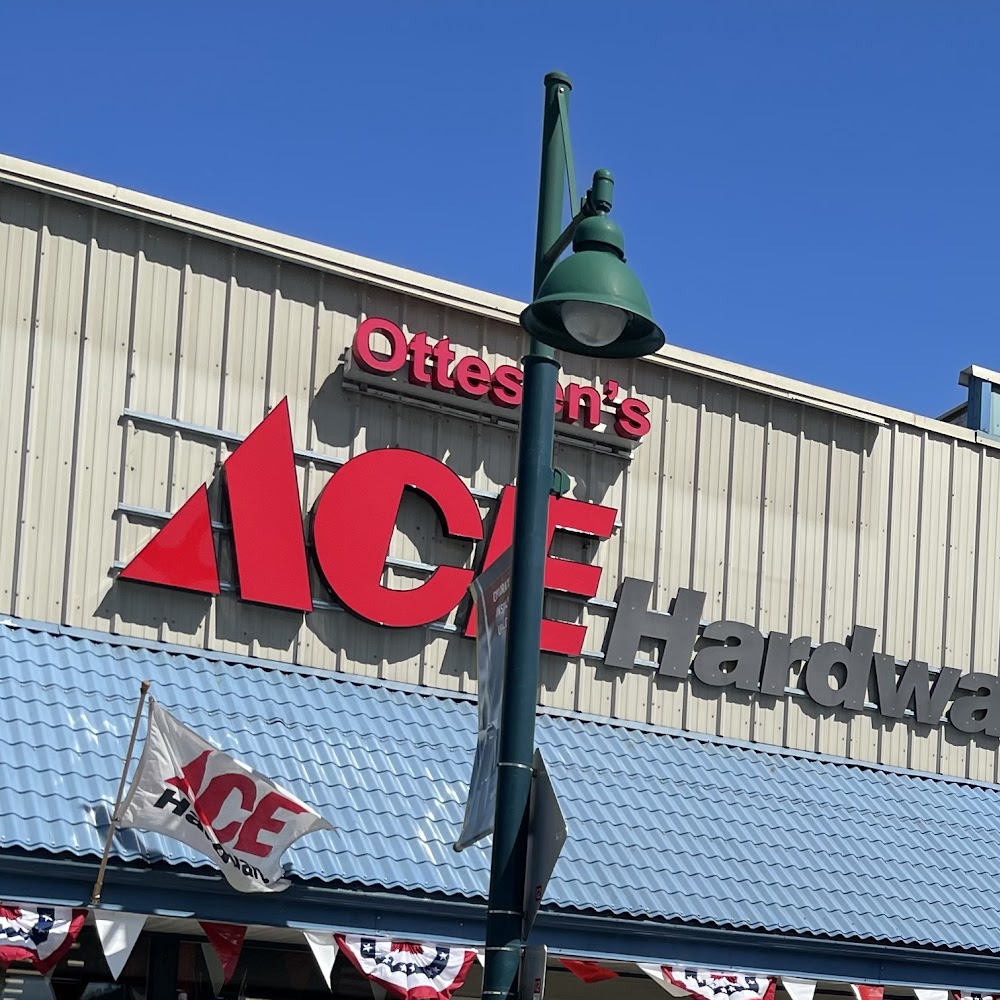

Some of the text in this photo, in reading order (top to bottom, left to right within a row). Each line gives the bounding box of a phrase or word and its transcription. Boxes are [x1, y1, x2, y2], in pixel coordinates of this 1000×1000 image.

[353, 316, 650, 440] Ottesn's
[118, 396, 618, 657] ACE
[164, 749, 310, 858] ACE
